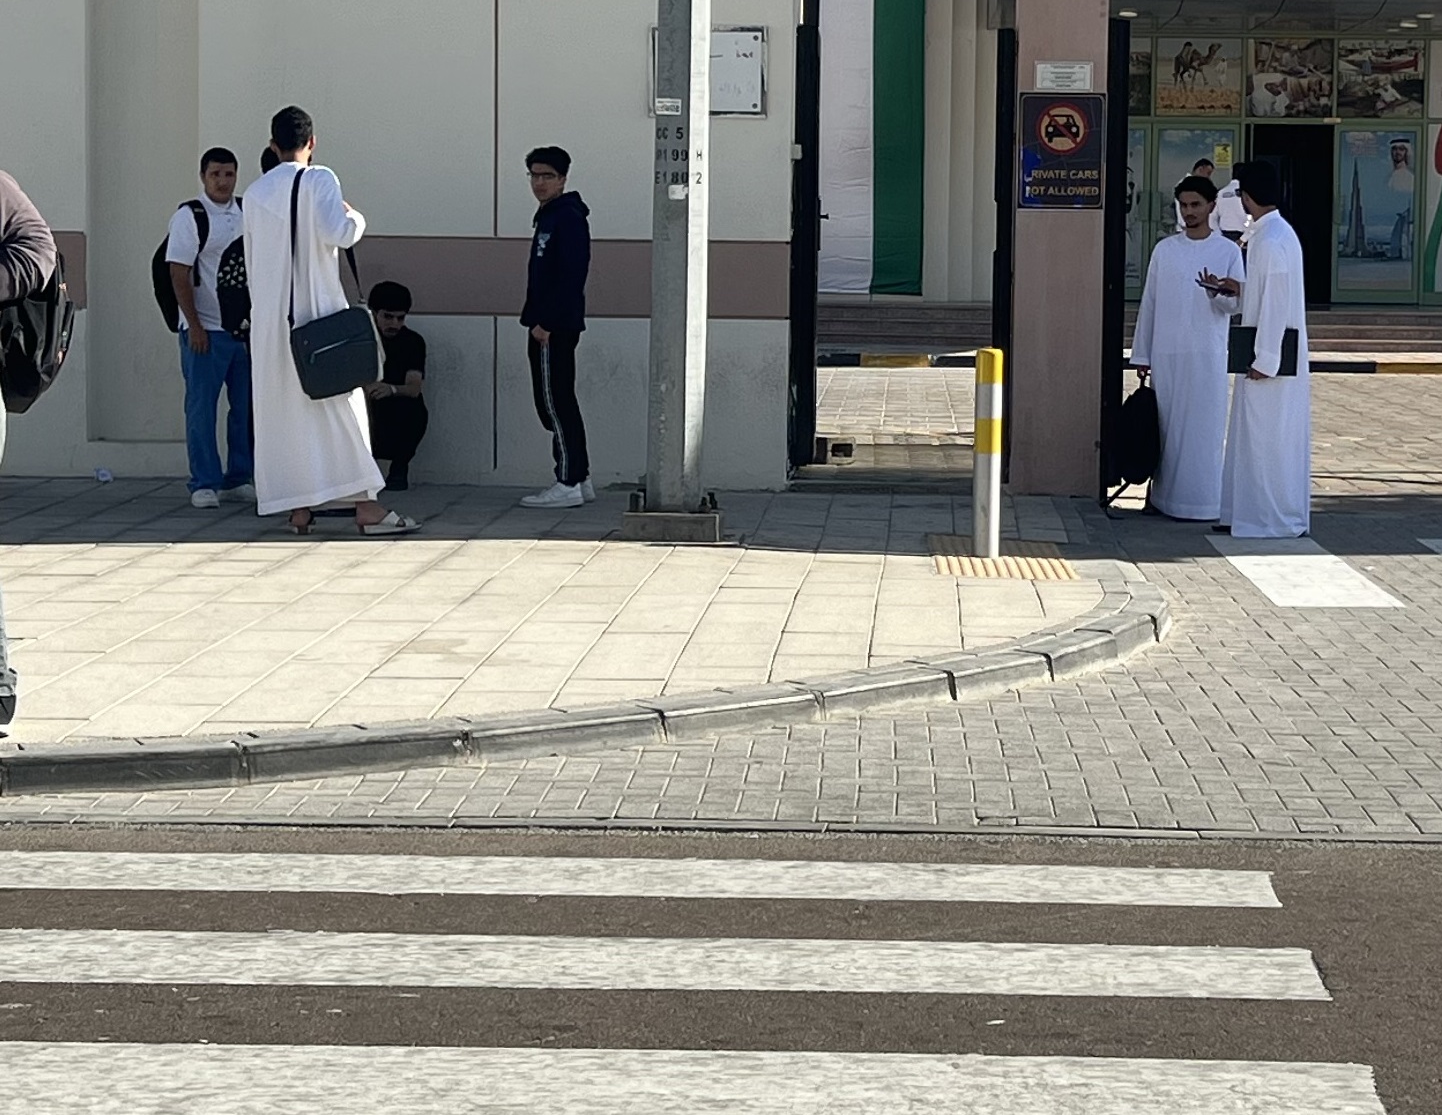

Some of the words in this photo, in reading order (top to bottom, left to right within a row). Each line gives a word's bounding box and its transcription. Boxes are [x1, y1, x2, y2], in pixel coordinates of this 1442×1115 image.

[675, 127, 684, 139] 5
[1025, 170, 1067, 180] RIVATE
[1069, 170, 1099, 180] CARS
[1047, 186, 1099, 196] ALLOWED
